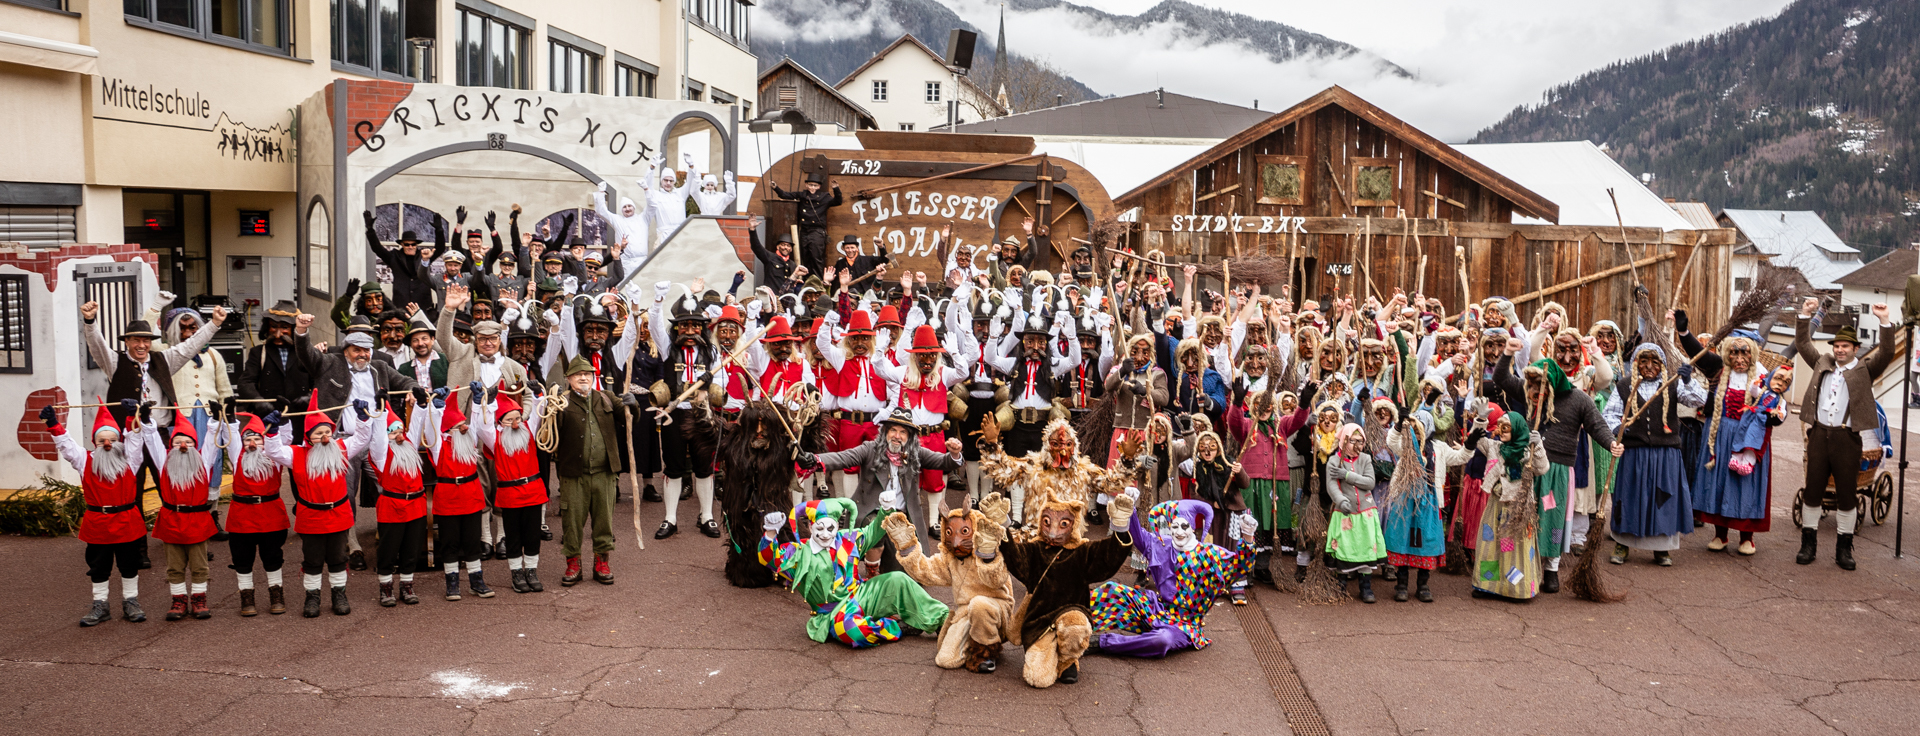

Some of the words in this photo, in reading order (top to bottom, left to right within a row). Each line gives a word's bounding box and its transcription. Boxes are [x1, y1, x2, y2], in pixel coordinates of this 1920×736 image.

[101, 76, 210, 119] Mittelschule
[864, 159, 882, 176] 92
[851, 190, 999, 230] FLIESSER
[93, 265, 113, 274] ZELLE
